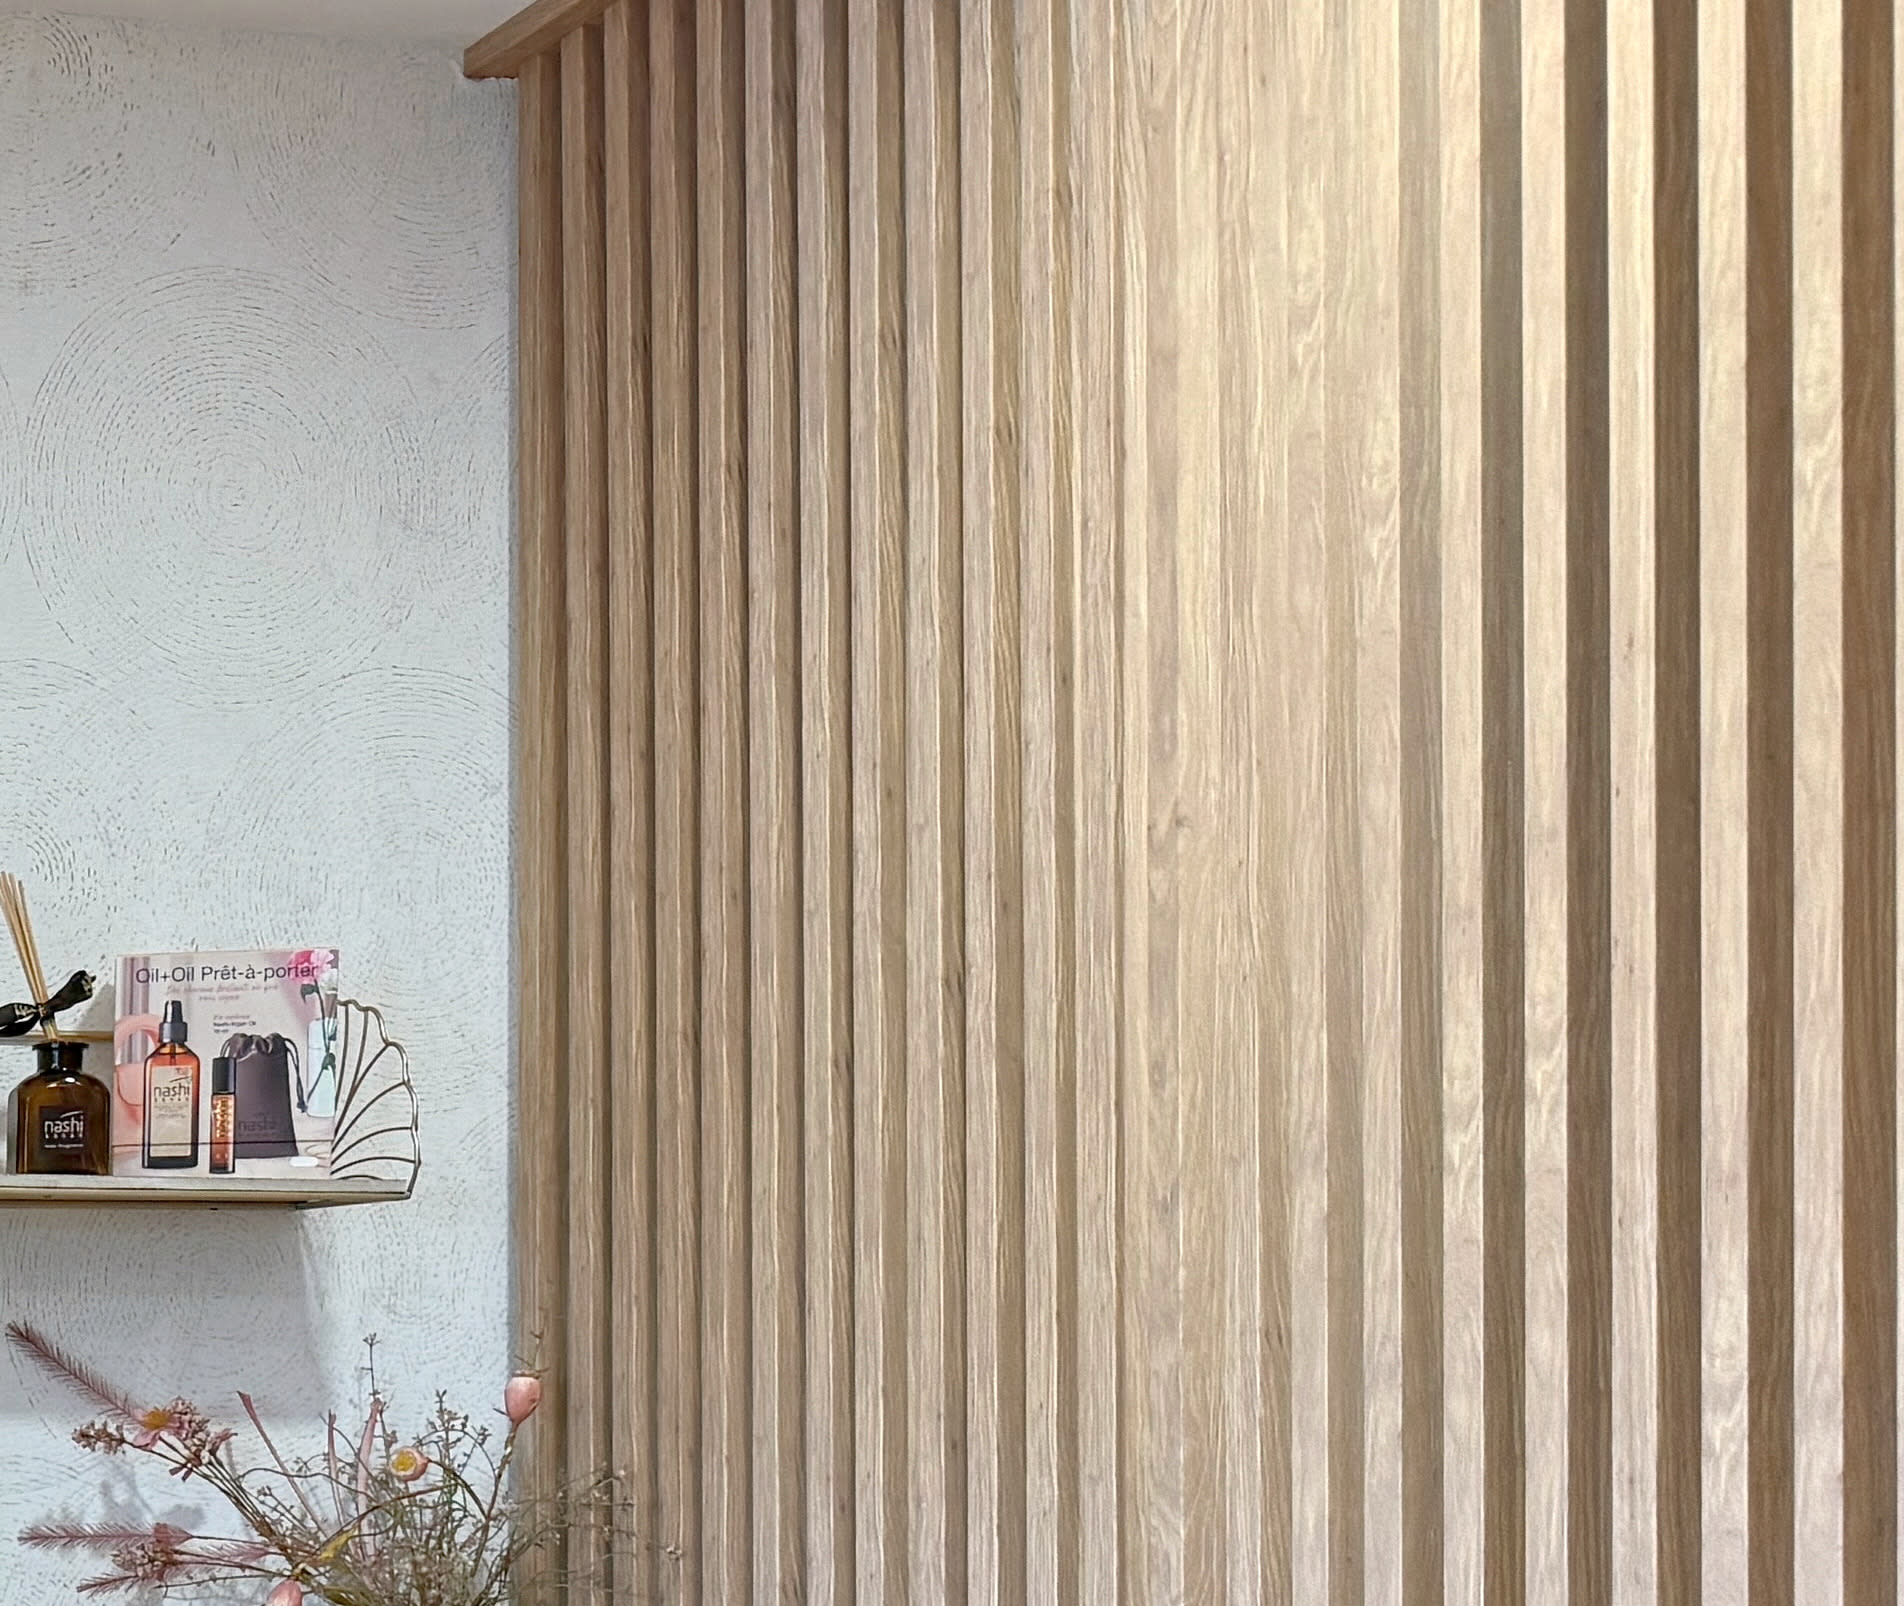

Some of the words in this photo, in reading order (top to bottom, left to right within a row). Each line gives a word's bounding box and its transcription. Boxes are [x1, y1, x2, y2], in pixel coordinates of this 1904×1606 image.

[135, 965, 195, 984] Oil+Oil
[201, 963, 318, 985] Prêt-à-porter
[154, 1082, 190, 1097] nashi
[44, 1115, 84, 1133] nashi
